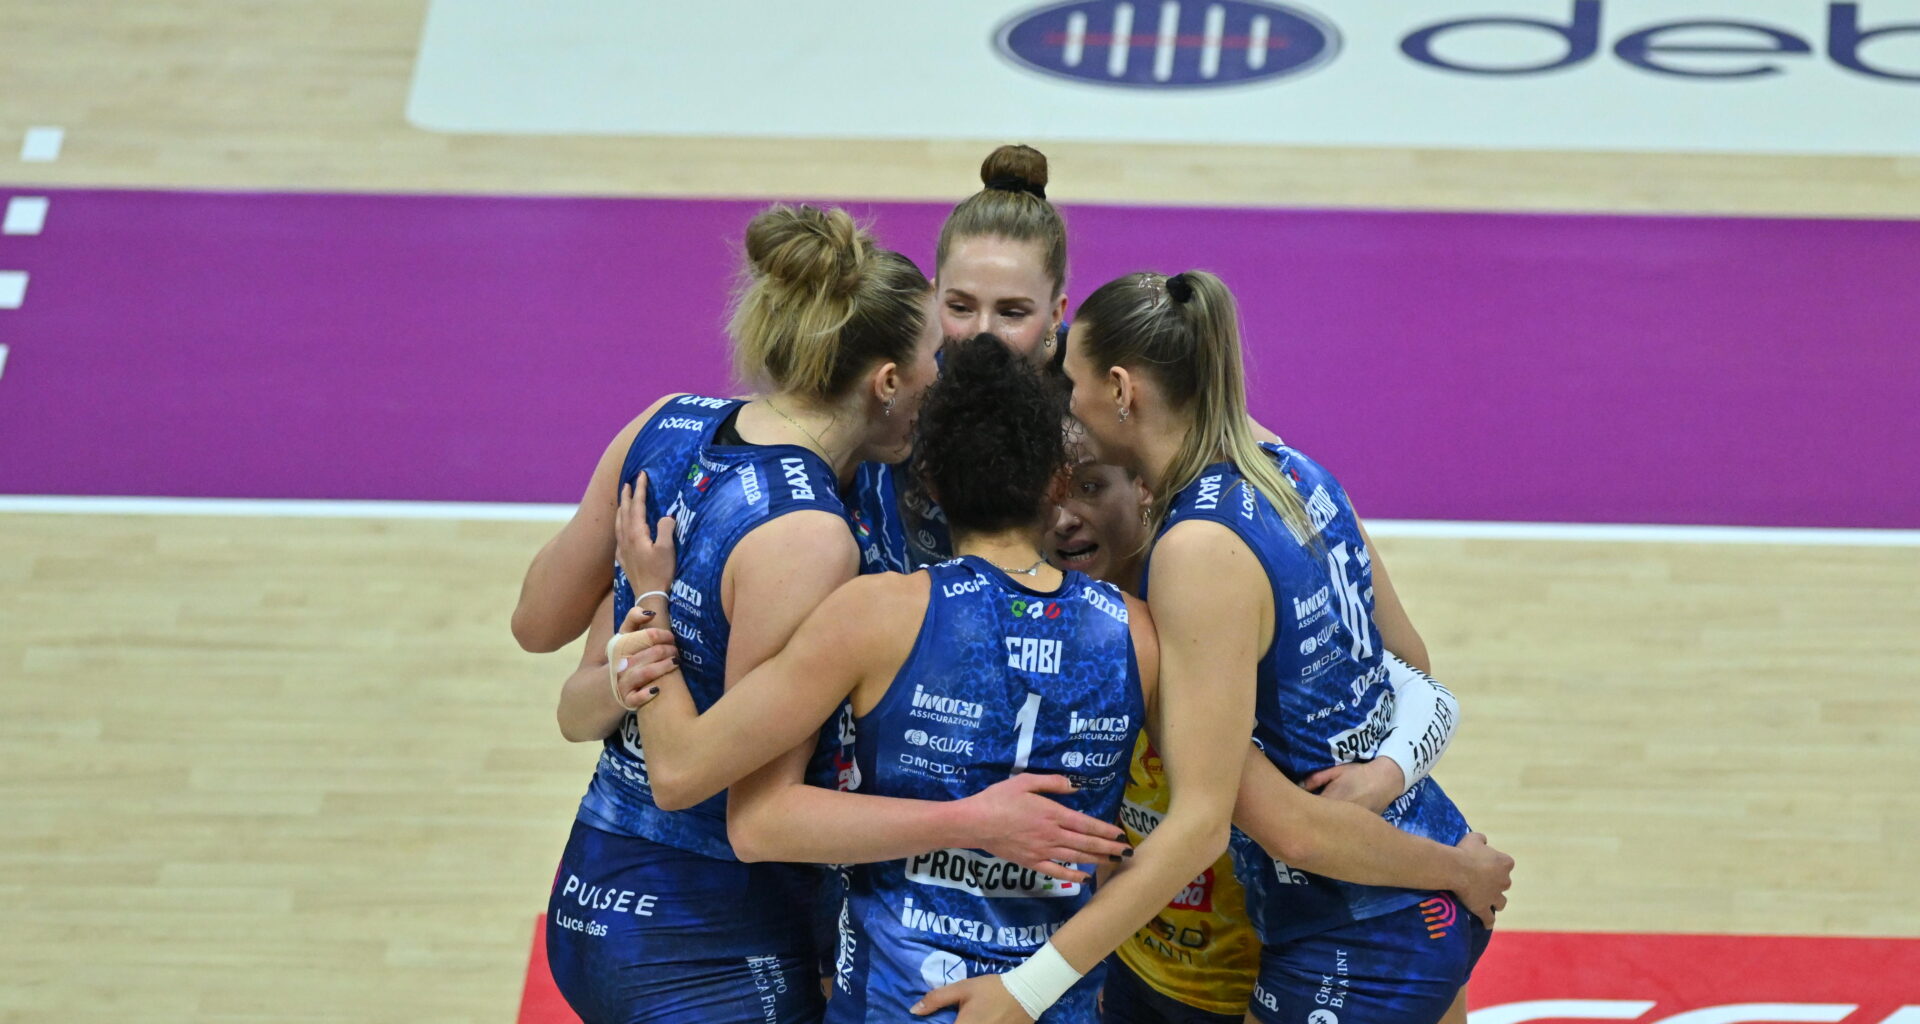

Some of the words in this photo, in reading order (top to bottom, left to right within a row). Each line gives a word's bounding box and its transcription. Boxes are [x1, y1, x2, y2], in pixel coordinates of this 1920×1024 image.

[780, 457, 815, 500] BAXI
[1195, 474, 1222, 510] BAXI
[1005, 636, 1063, 674] GABI
[909, 708, 980, 728] ASSICURAZIONI
[1009, 692, 1042, 779] 1
[929, 735, 975, 757] ECLISSE
[562, 874, 659, 917] PULSEE
[556, 908, 584, 932] Luce
[588, 920, 608, 937] Gas
